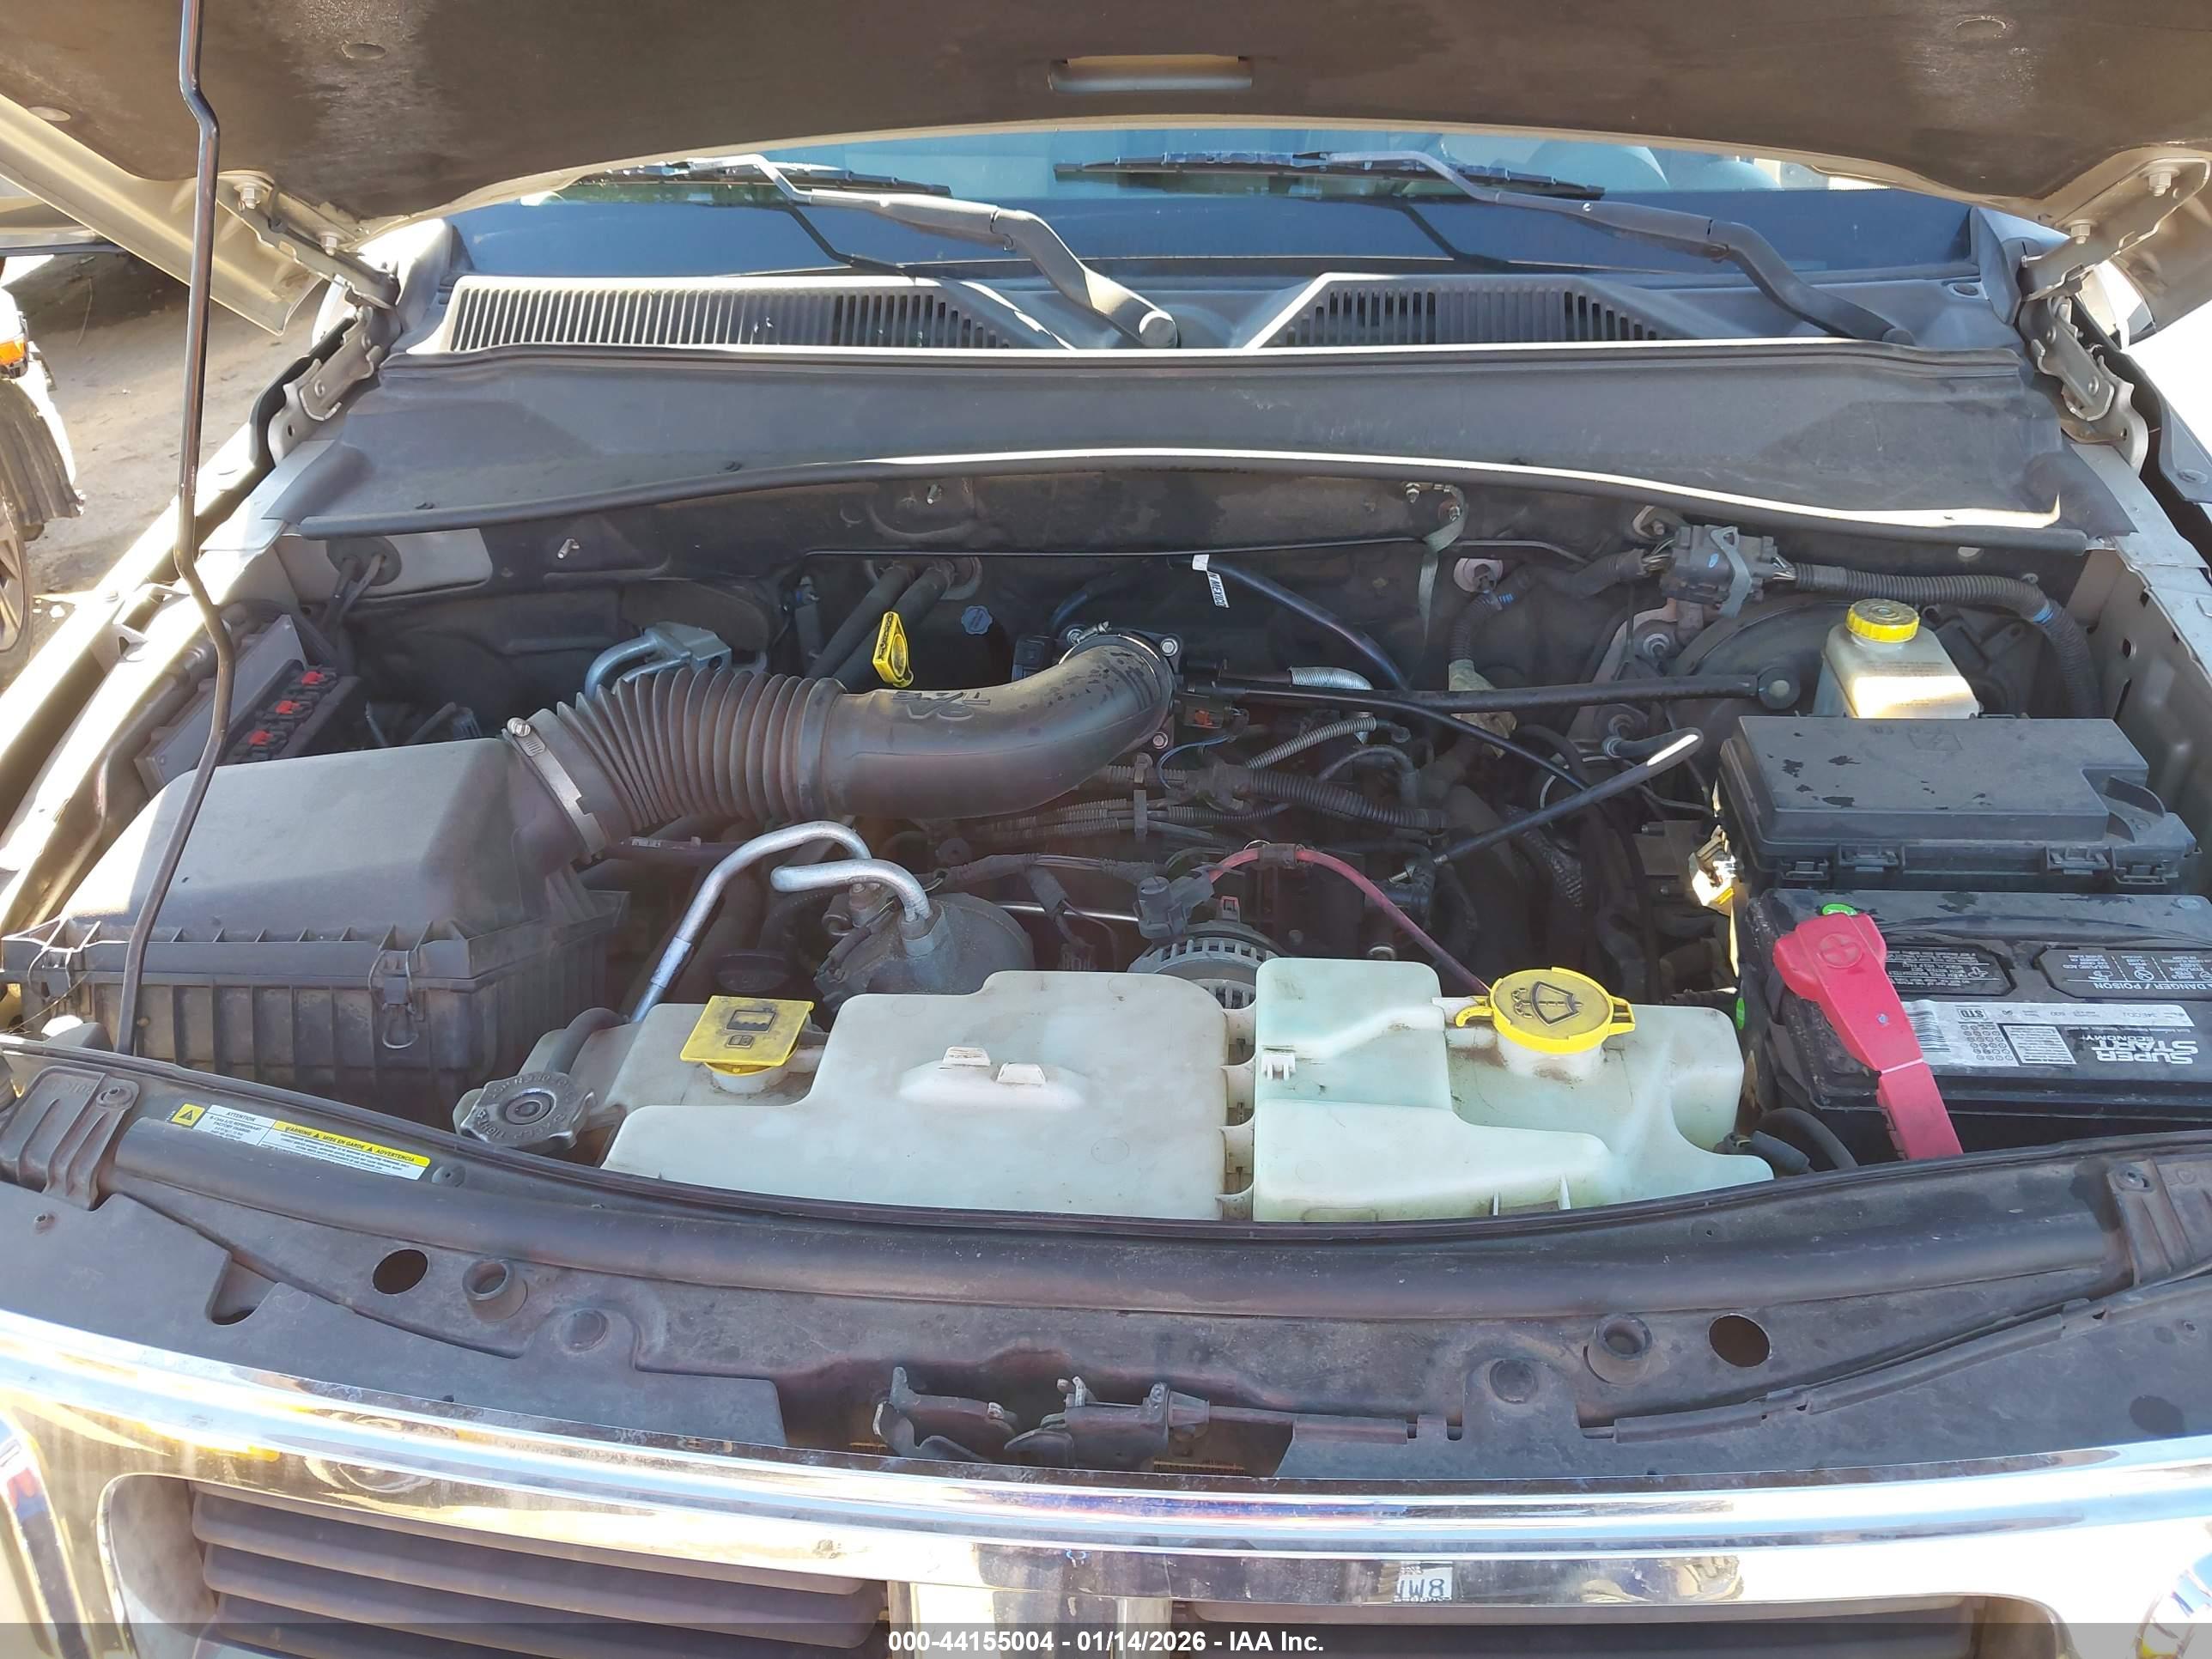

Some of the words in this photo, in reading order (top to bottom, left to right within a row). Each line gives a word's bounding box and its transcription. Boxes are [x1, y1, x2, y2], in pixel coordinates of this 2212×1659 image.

[1211, 580, 1226, 607] MEXICO
[1960, 1009, 1984, 1018] STD
[2091, 1040, 2199, 1054] START
[2095, 1050, 2194, 1065] SUPER
[225, 1111, 257, 1121] ATTENTION
[284, 1126, 312, 1136] WARNING
[374, 1149, 416, 1162] ADVERTENCIA
